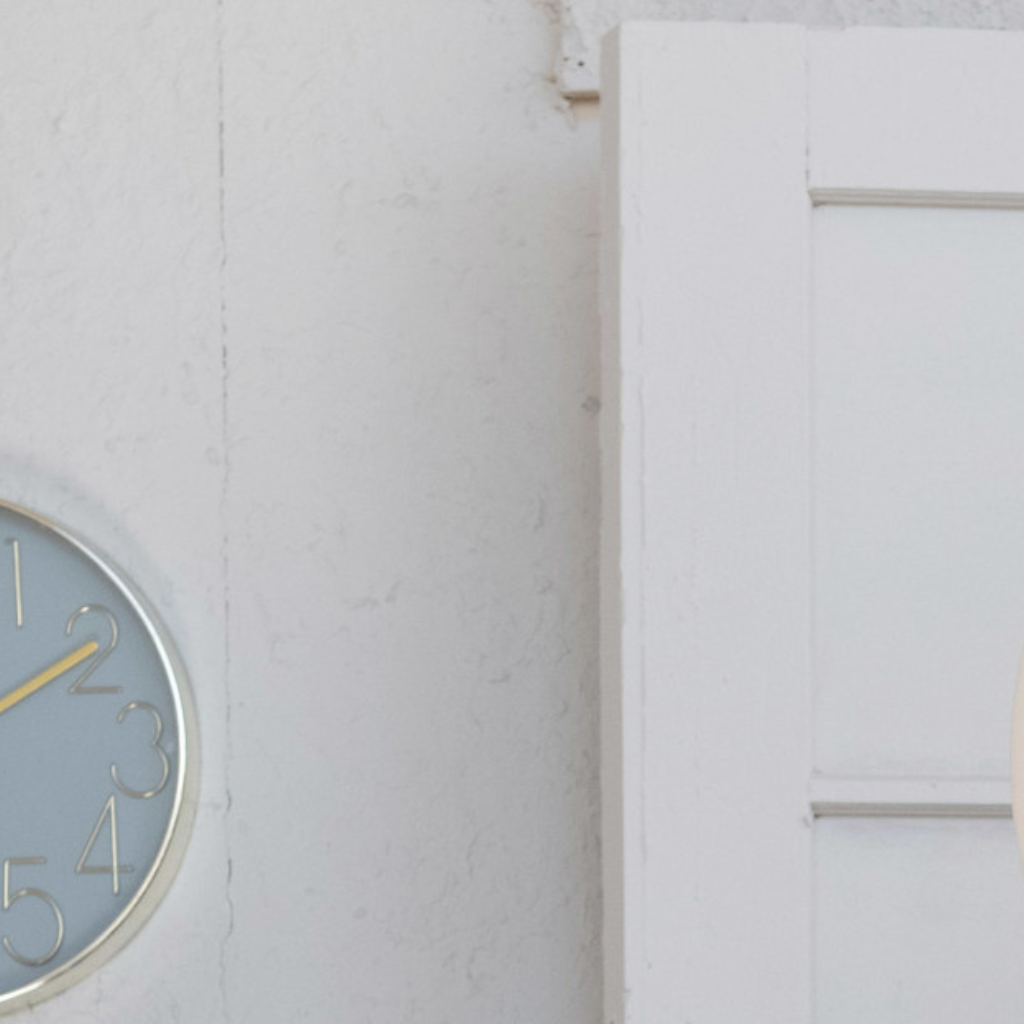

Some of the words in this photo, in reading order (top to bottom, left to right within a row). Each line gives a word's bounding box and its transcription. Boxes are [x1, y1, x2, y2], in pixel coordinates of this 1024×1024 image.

[4, 538, 23, 629] 1
[65, 604, 123, 694] 2
[111, 701, 168, 798] 3
[75, 795, 134, 895] 4
[2, 857, 64, 968] 5
